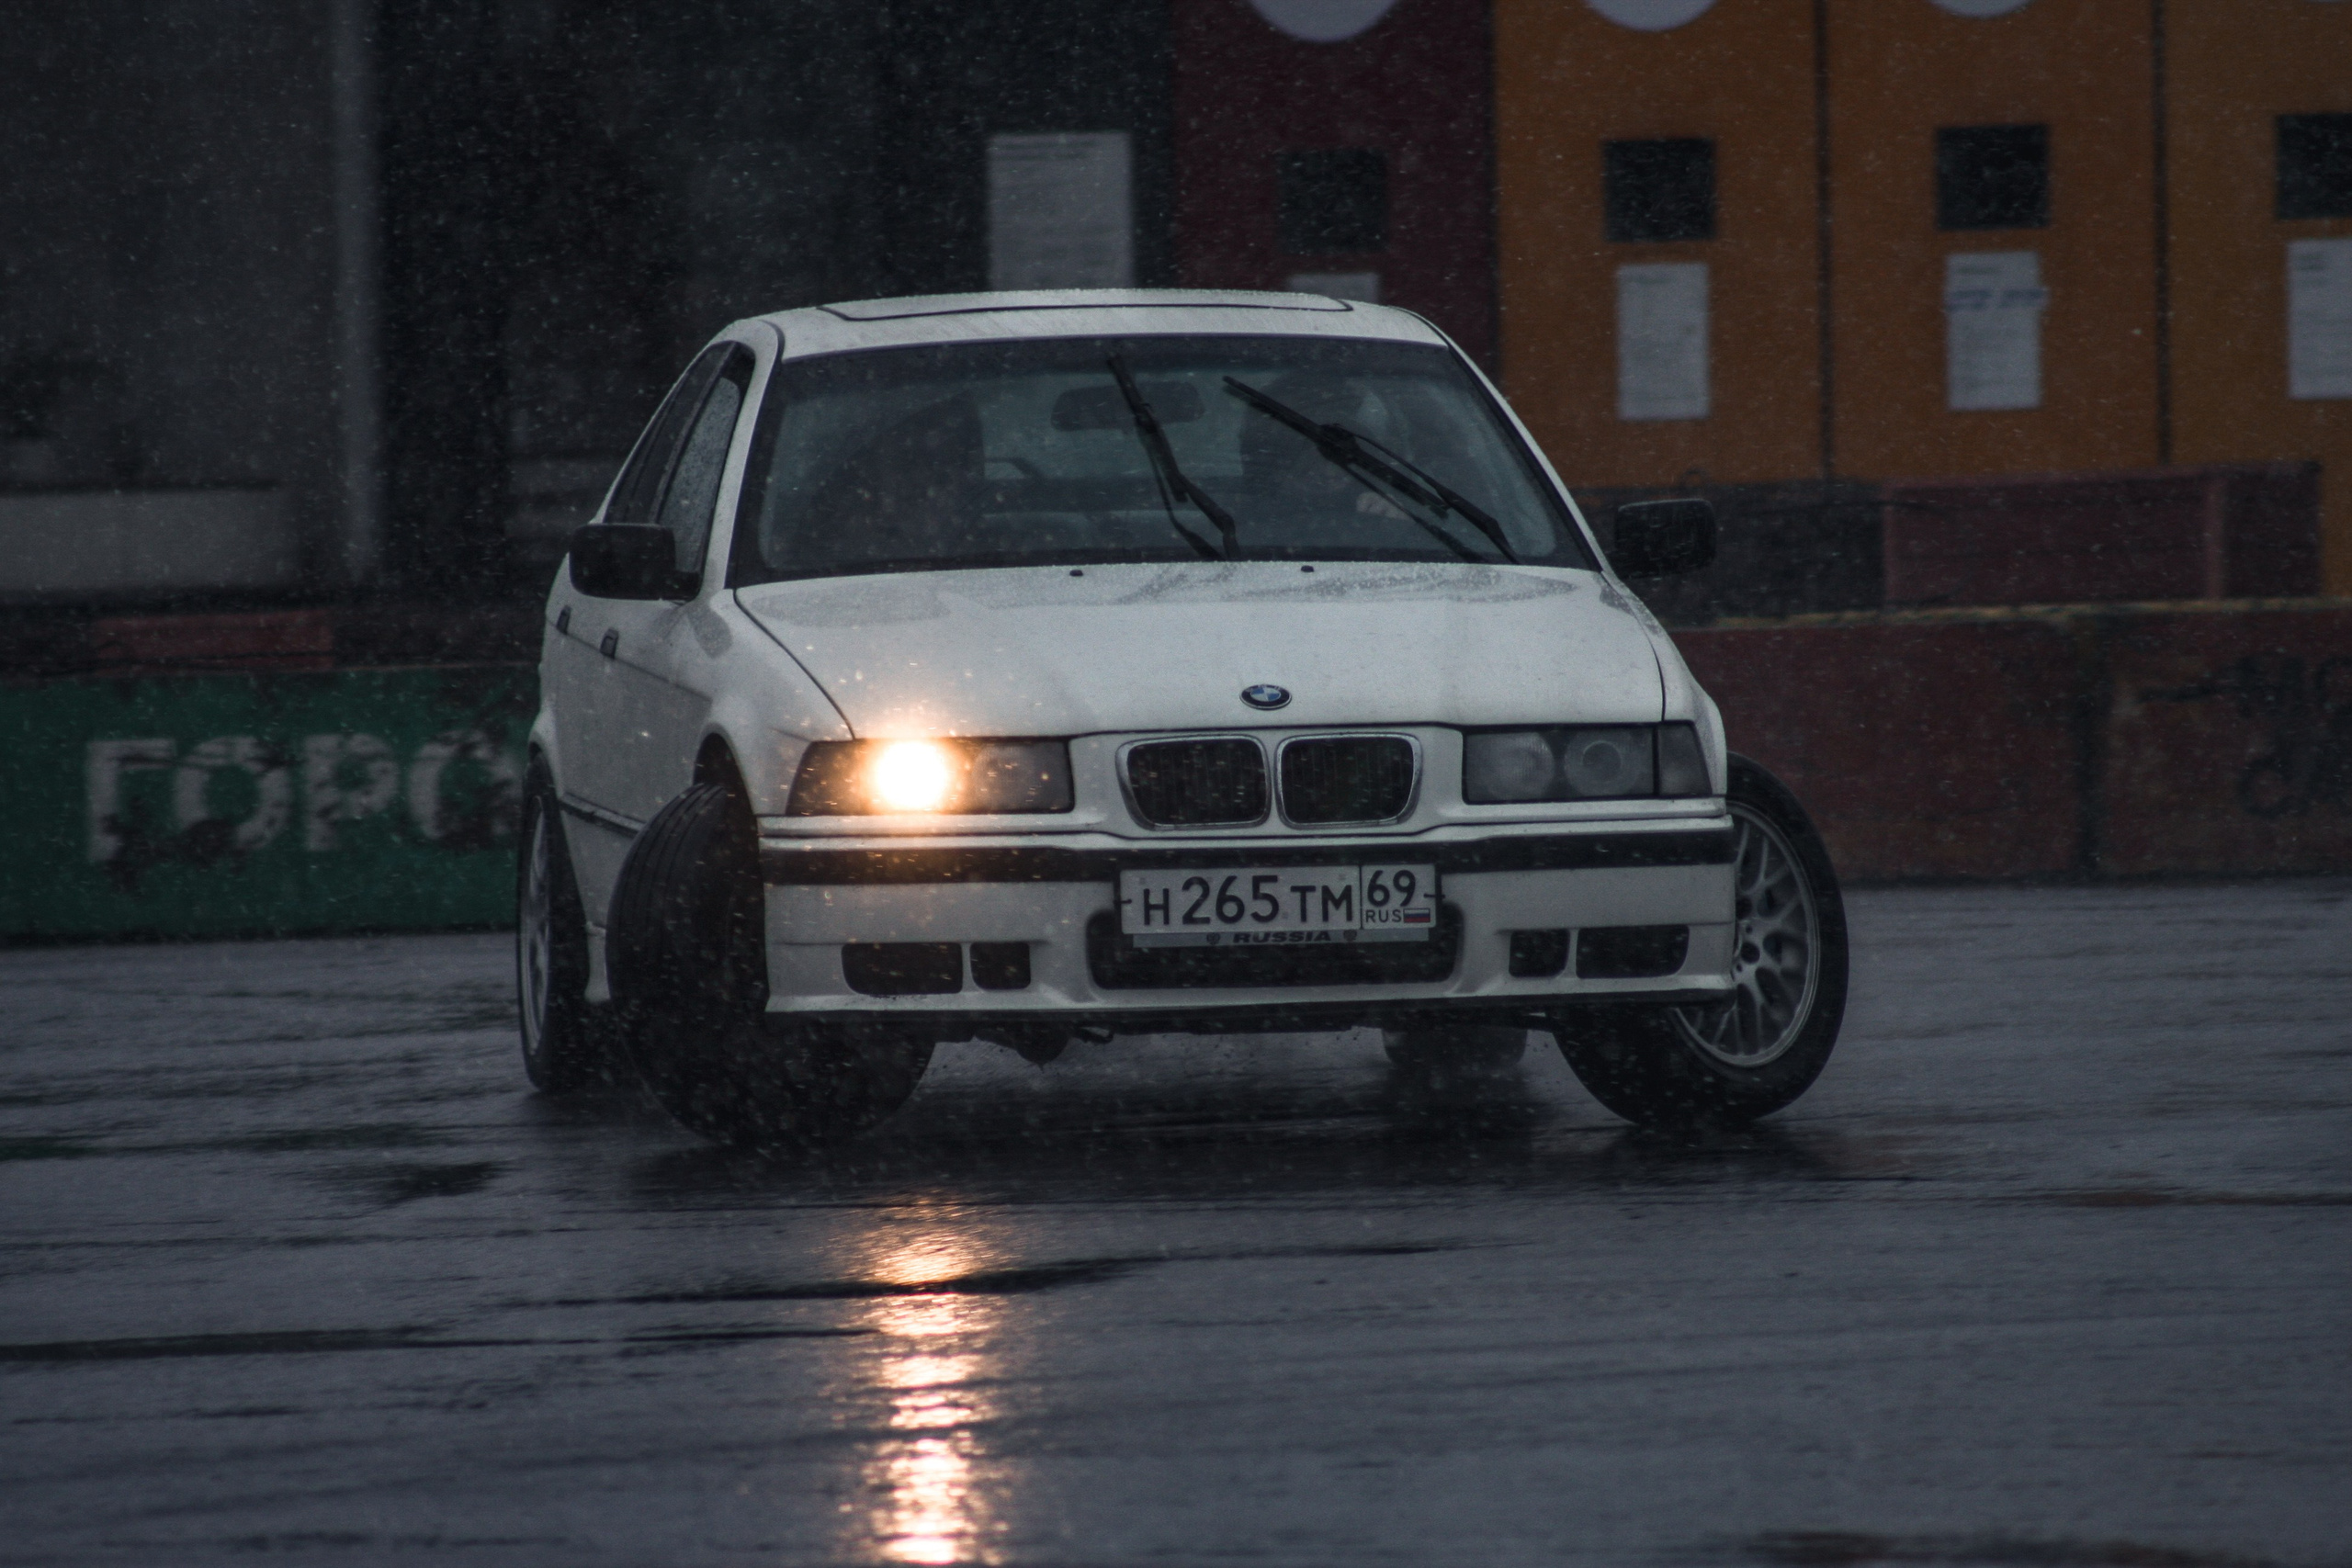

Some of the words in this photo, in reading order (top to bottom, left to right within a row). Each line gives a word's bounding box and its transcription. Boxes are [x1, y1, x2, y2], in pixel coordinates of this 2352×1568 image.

[1366, 869, 1418, 908] 69
[1364, 908, 1403, 924] RUS
[1232, 930, 1332, 944] RUSSIA
